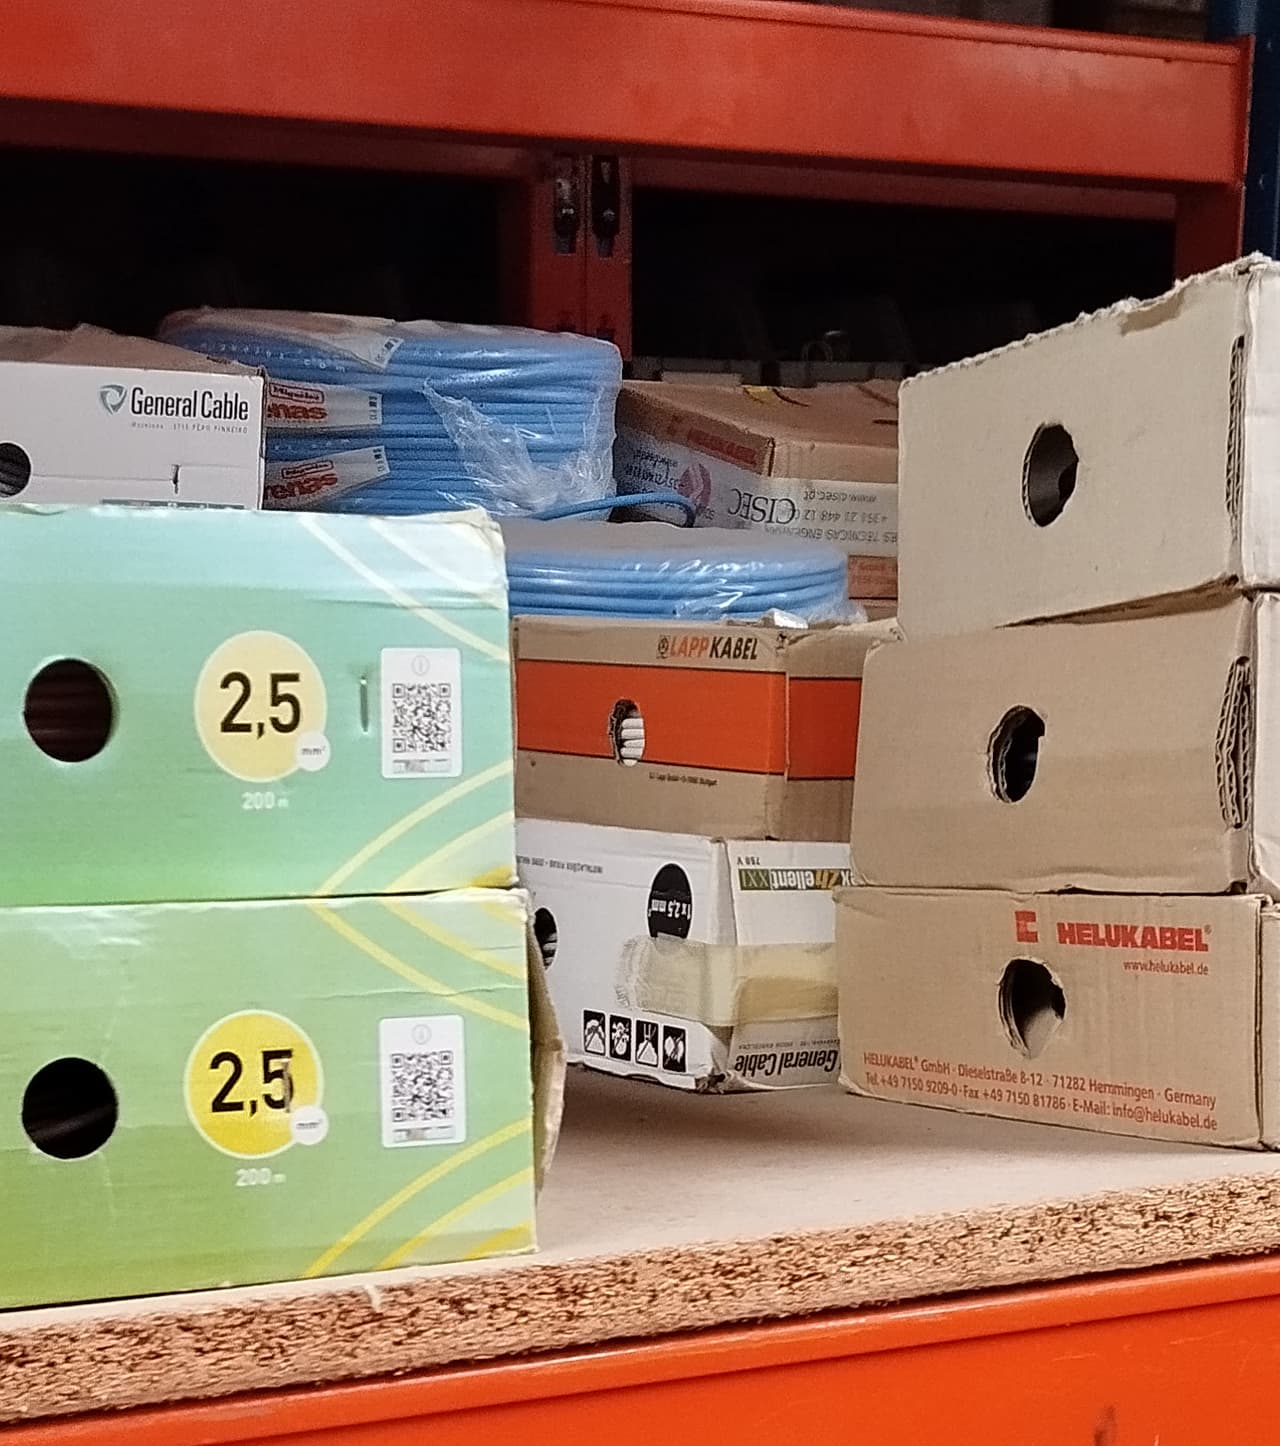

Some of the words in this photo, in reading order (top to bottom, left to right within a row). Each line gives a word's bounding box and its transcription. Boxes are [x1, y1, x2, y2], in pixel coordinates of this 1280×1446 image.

[130, 386, 198, 419] General
[201, 390, 250, 421] Cable
[220, 671, 301, 740] 2,5
[241, 792, 276, 810] 200
[1123, 958, 1209, 976] www.helukabel.de
[734, 1053, 778, 1077] Cable
[778, 1050, 840, 1075] General
[209, 1048, 294, 1116] 2,5
[1052, 1074, 1086, 1092] 71282
[1089, 1079, 1155, 1101] Hemmingen
[1164, 1088, 1217, 1111] Germany
[1112, 1103, 1217, 1131] info@helukabel.de
